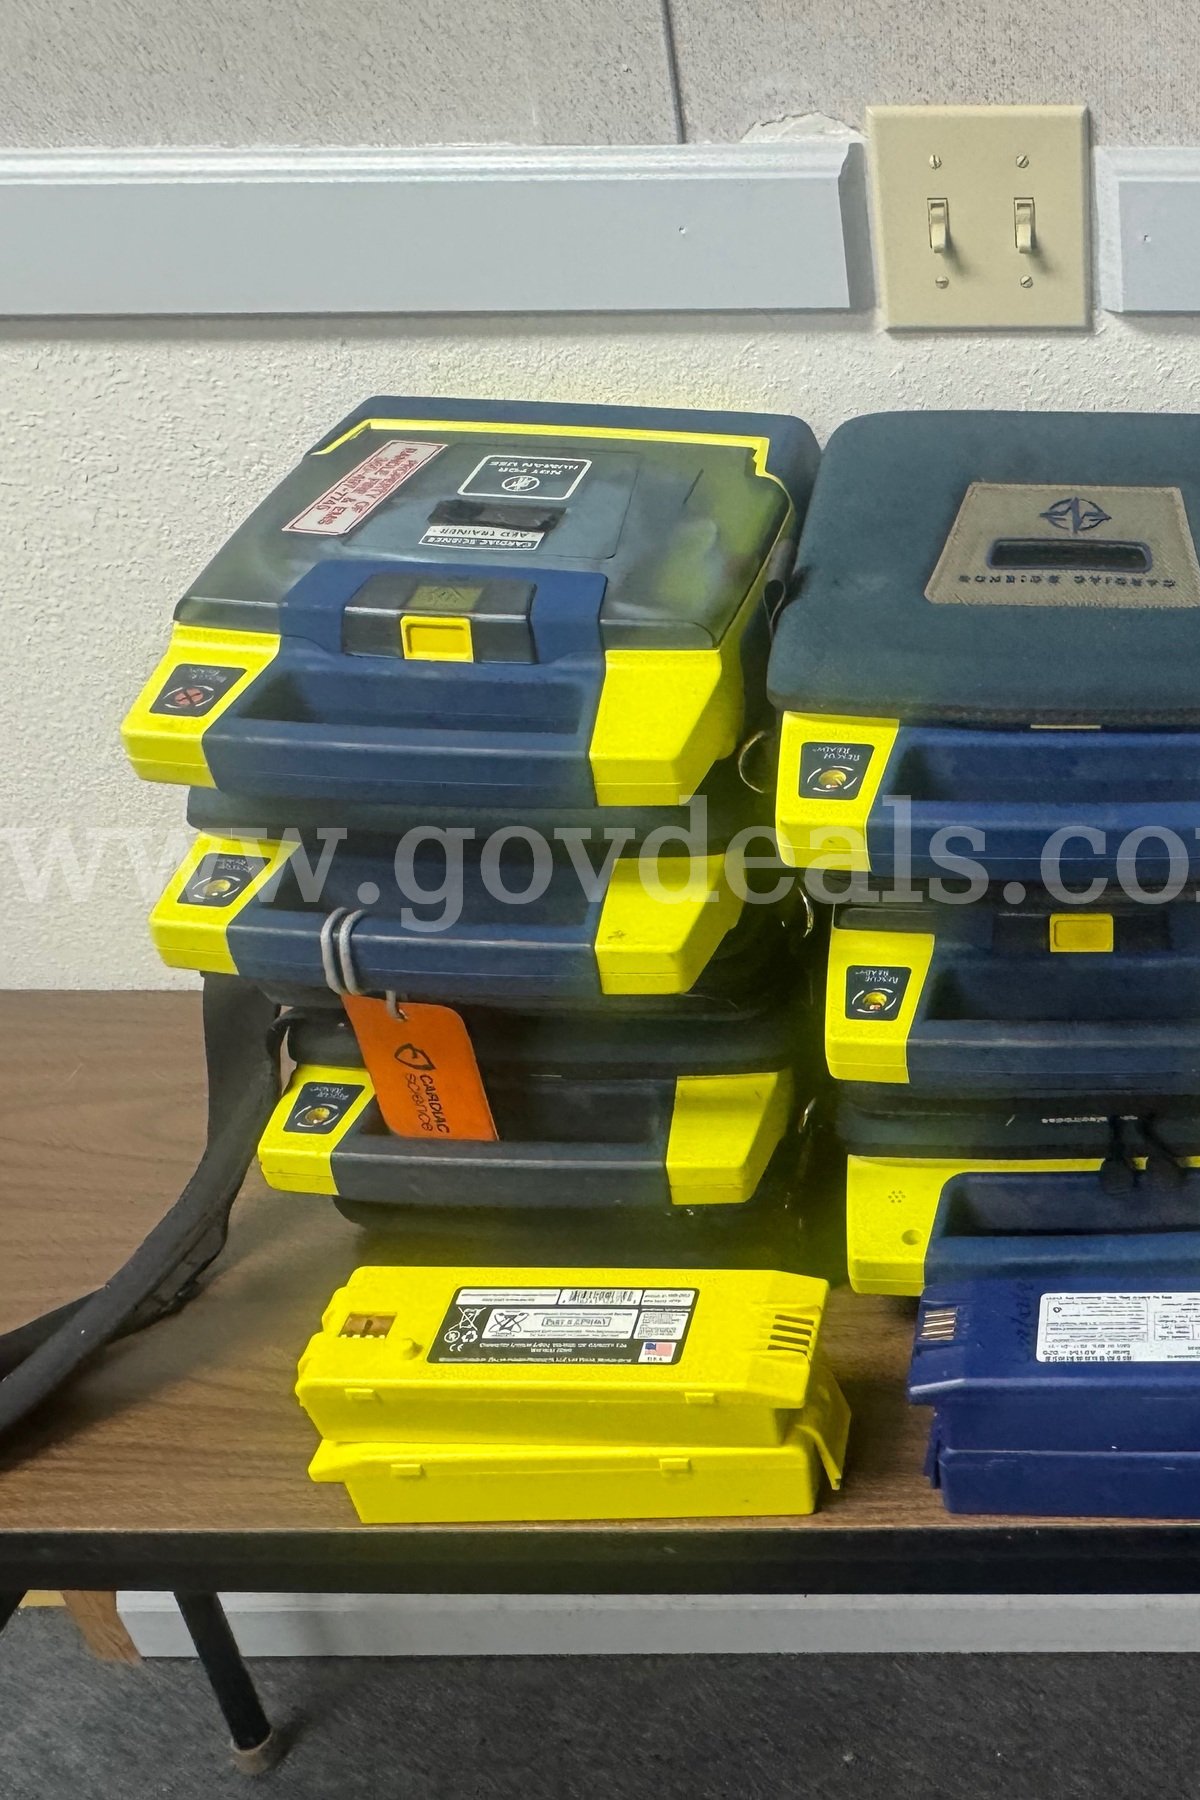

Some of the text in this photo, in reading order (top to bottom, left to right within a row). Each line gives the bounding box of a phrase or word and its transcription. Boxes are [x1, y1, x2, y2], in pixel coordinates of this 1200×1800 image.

[522, 462, 579, 470] HUMAN
[480, 539, 532, 548] CARDIAC
[420, 1074, 450, 1134] CARDIAC
